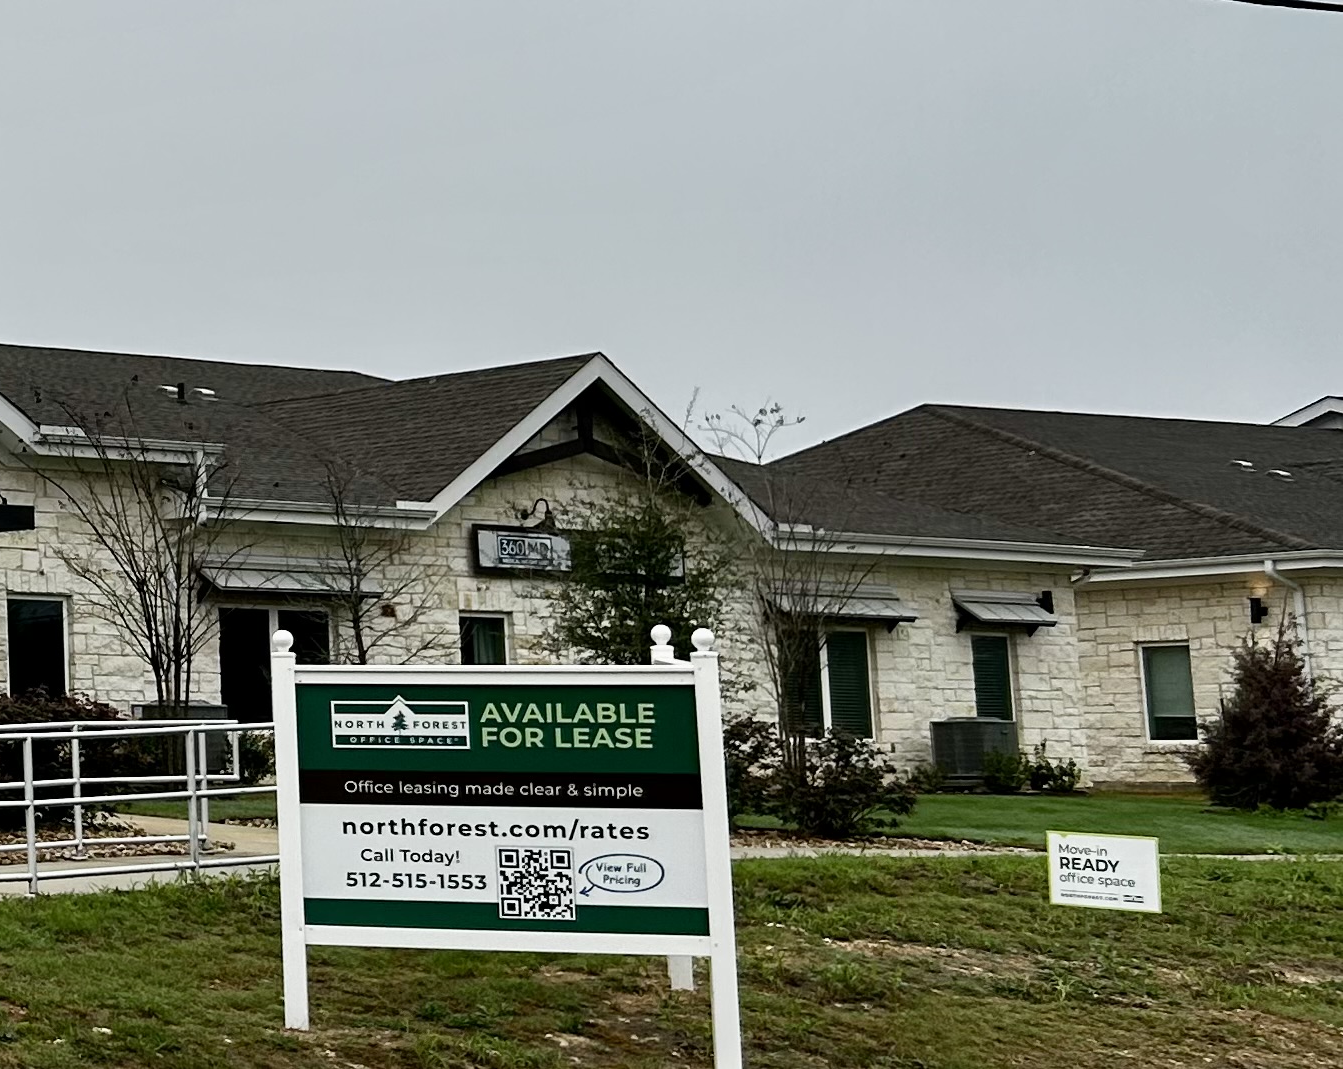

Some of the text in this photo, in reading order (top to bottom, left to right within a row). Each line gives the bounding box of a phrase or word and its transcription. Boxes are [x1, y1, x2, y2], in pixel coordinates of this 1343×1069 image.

[501, 540, 525, 556] 360
[479, 702, 655, 724] AVAILABLE
[335, 720, 466, 729] NORTH FOREST
[349, 736, 400, 744] OFFICE
[481, 726, 653, 748] FOR LEASE
[344, 780, 644, 800] Office leasing made clear & simple
[342, 818, 650, 840] northforest.com/rates
[361, 848, 461, 867] Call Today!
[1059, 844, 1107, 856] Move-in
[595, 862, 647, 872] View Full
[1059, 856, 1119, 872] READY
[346, 872, 487, 890] 512-515-1553
[603, 874, 641, 888] Pricing
[1059, 872, 1135, 888] office space
